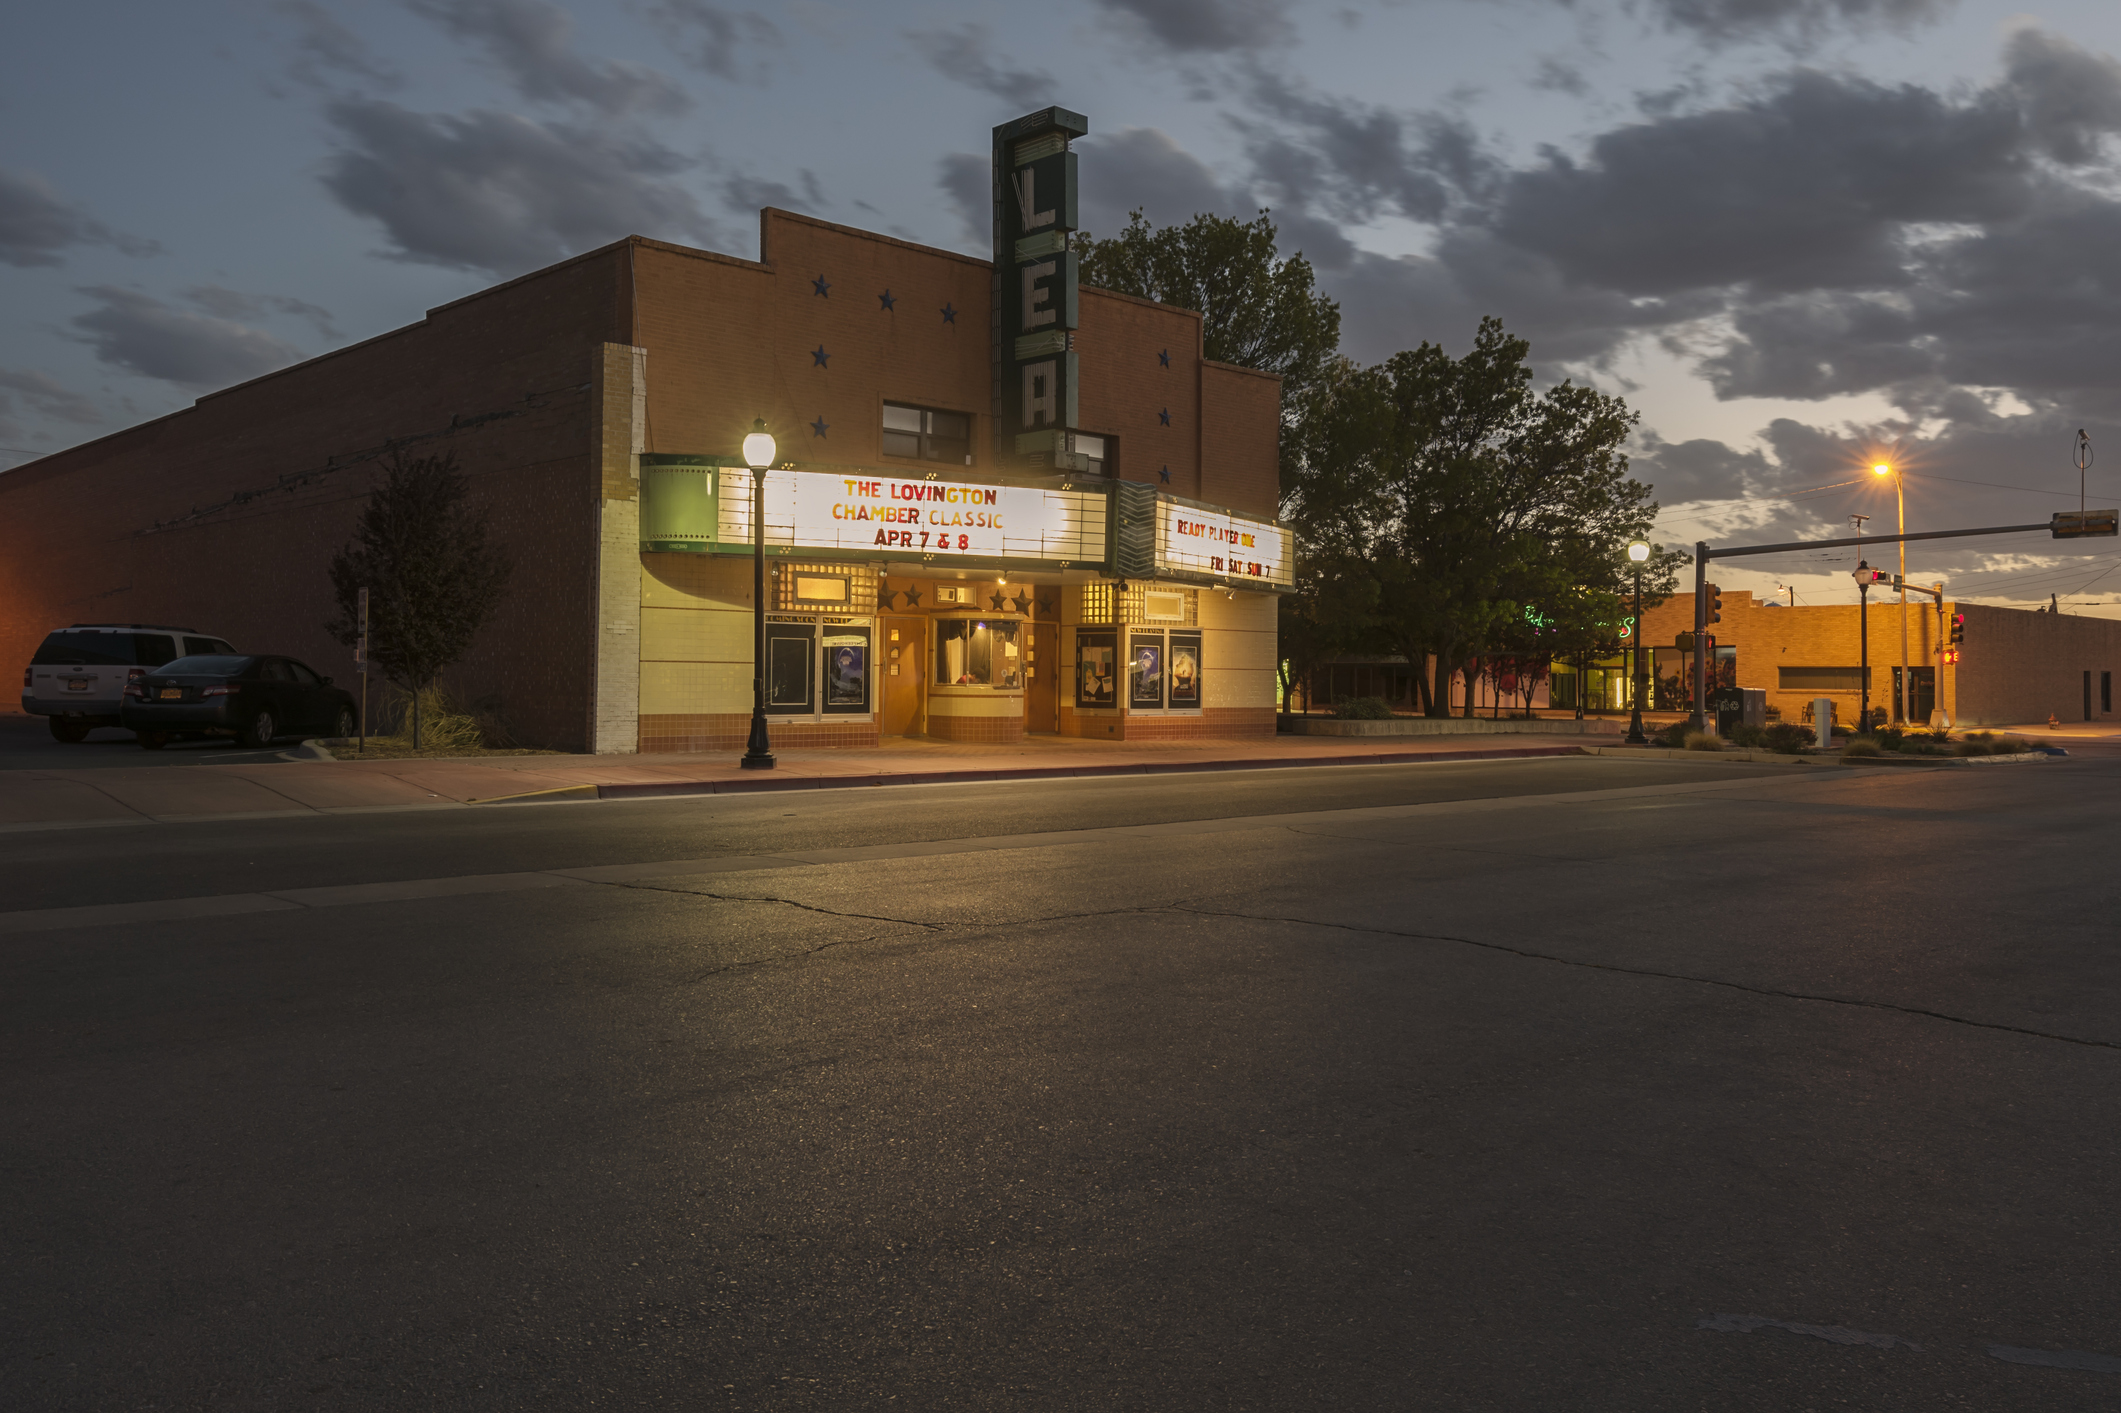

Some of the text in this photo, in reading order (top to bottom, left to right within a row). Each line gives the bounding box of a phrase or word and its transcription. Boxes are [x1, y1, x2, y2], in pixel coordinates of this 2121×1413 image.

[1021, 165, 1057, 430] LEA
[844, 479, 997, 505] THE LOVINGTON
[832, 503, 1003, 529] CHAMBER CLASSIC
[874, 528, 969, 550] APR 7 & 8
[1177, 519, 1206, 538] READY
[1208, 526, 1239, 544] PLAYER
[1210, 556, 1270, 578] FRI SAT SUN 7
